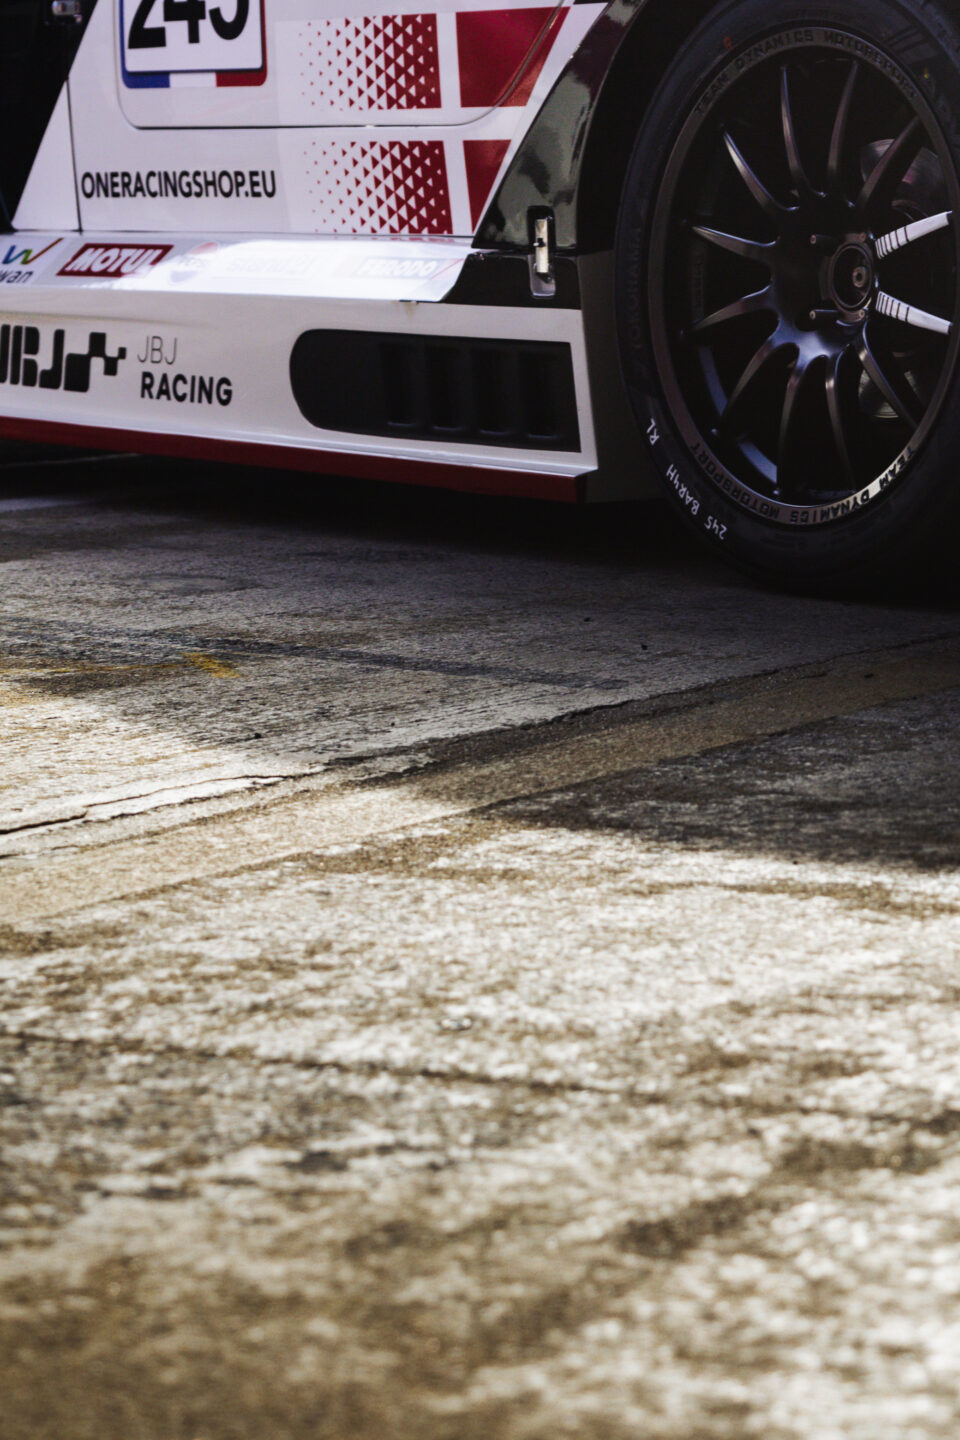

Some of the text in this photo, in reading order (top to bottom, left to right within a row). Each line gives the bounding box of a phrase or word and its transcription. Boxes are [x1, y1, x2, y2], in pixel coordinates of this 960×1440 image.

[735, 29, 814, 68] DYNAMICS
[81, 169, 277, 200] ONERACINGSHOP.EU
[64, 247, 163, 273] MOTUL
[137, 335, 178, 365] JBJ
[140, 371, 233, 407] RACING
[689, 442, 915, 524] TEAM DYNAMICS MOTORSPORT
